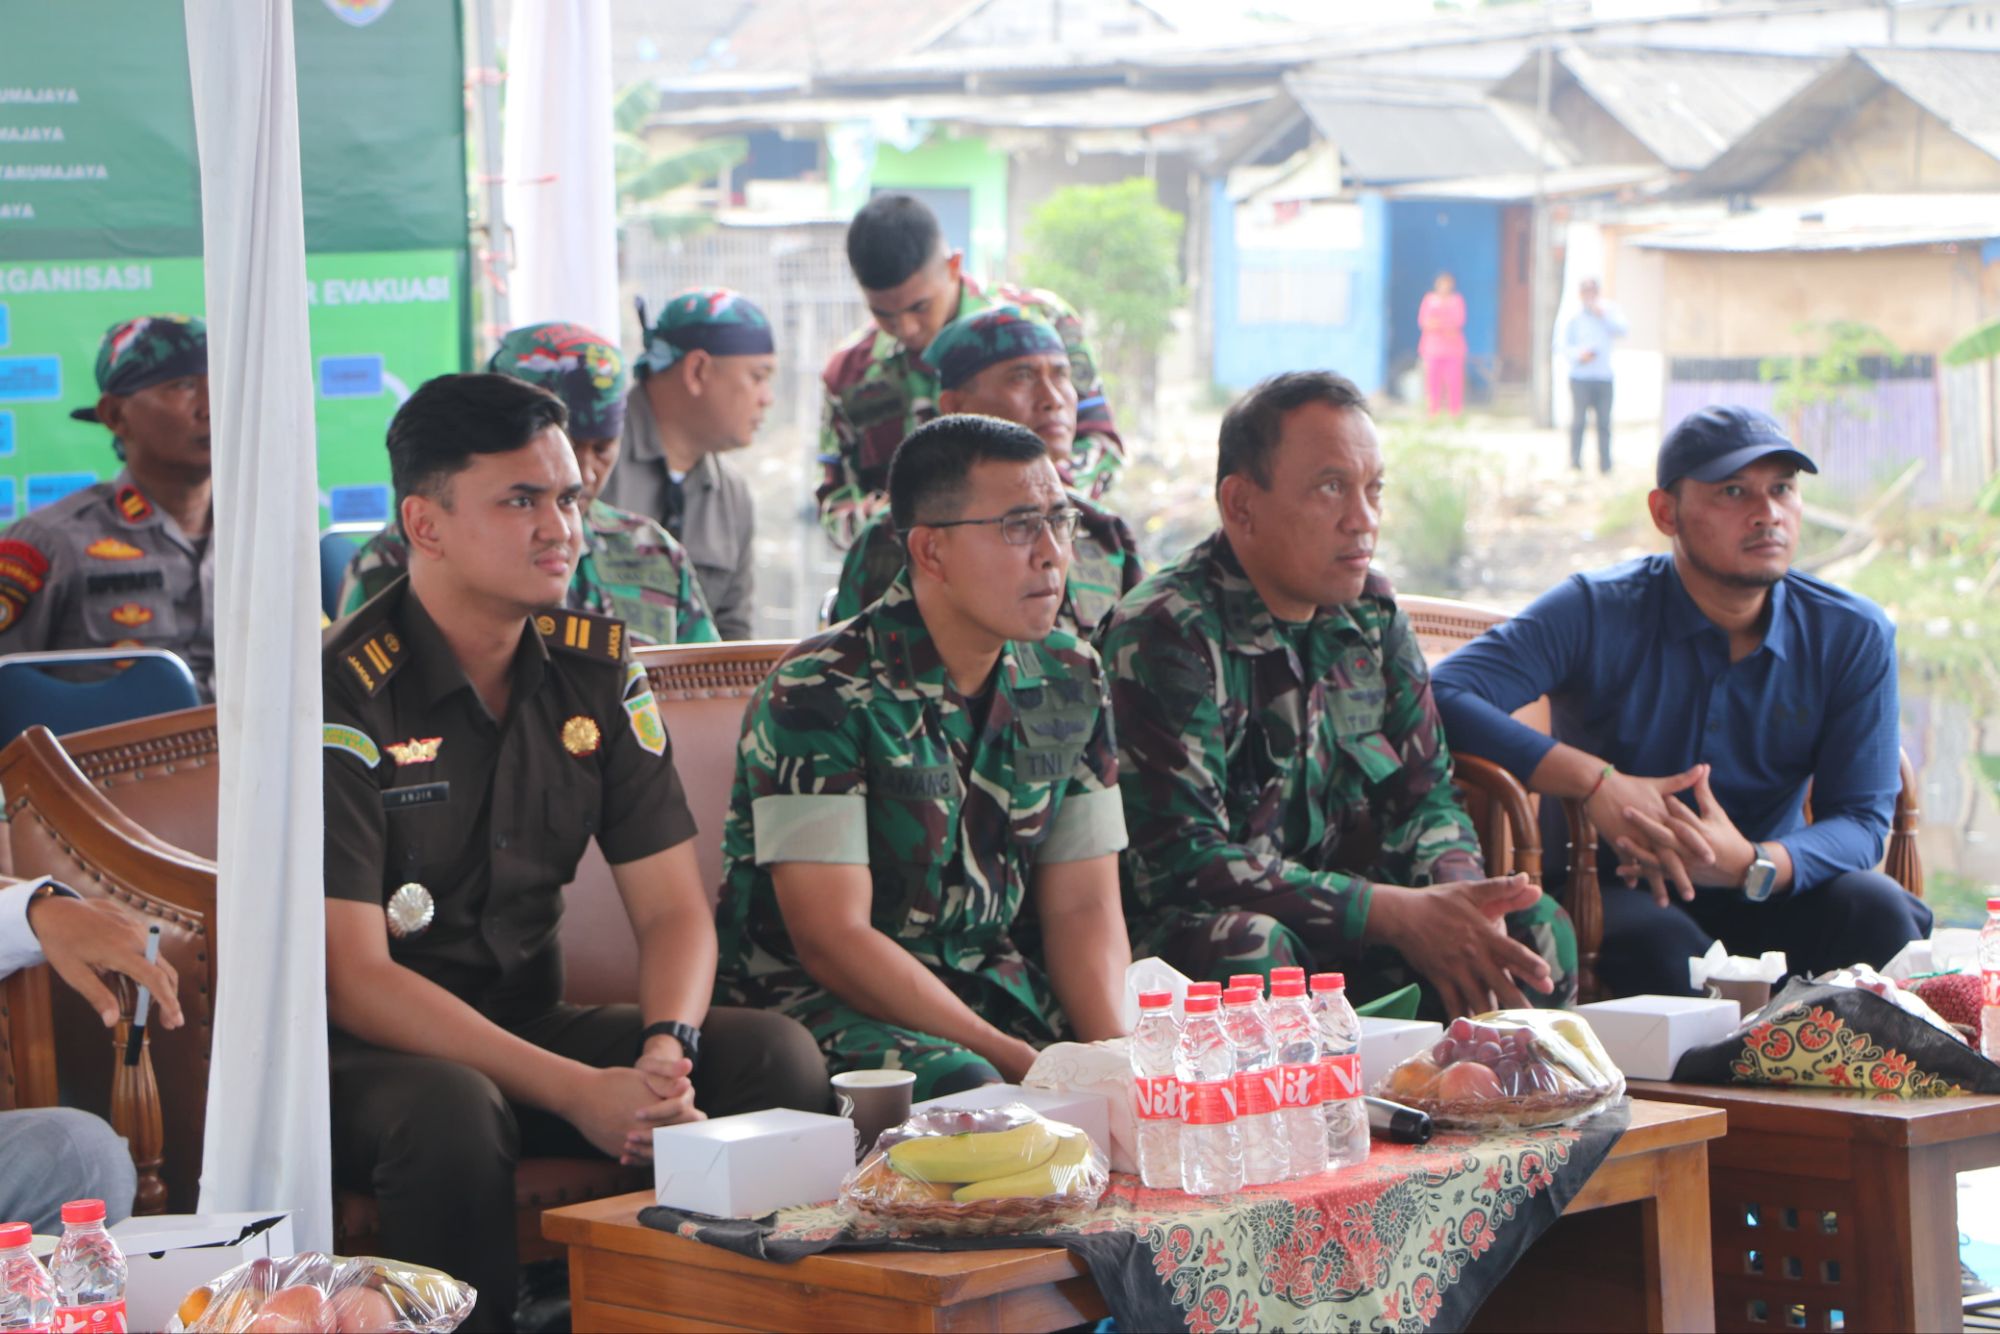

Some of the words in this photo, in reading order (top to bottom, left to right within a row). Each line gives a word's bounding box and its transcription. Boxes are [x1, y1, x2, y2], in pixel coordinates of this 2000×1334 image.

[323, 276, 450, 305] EVAKUASI
[607, 624, 622, 660] JAKSA
[347, 655, 375, 691] JAKSA
[1025, 752, 1063, 776] TNI
